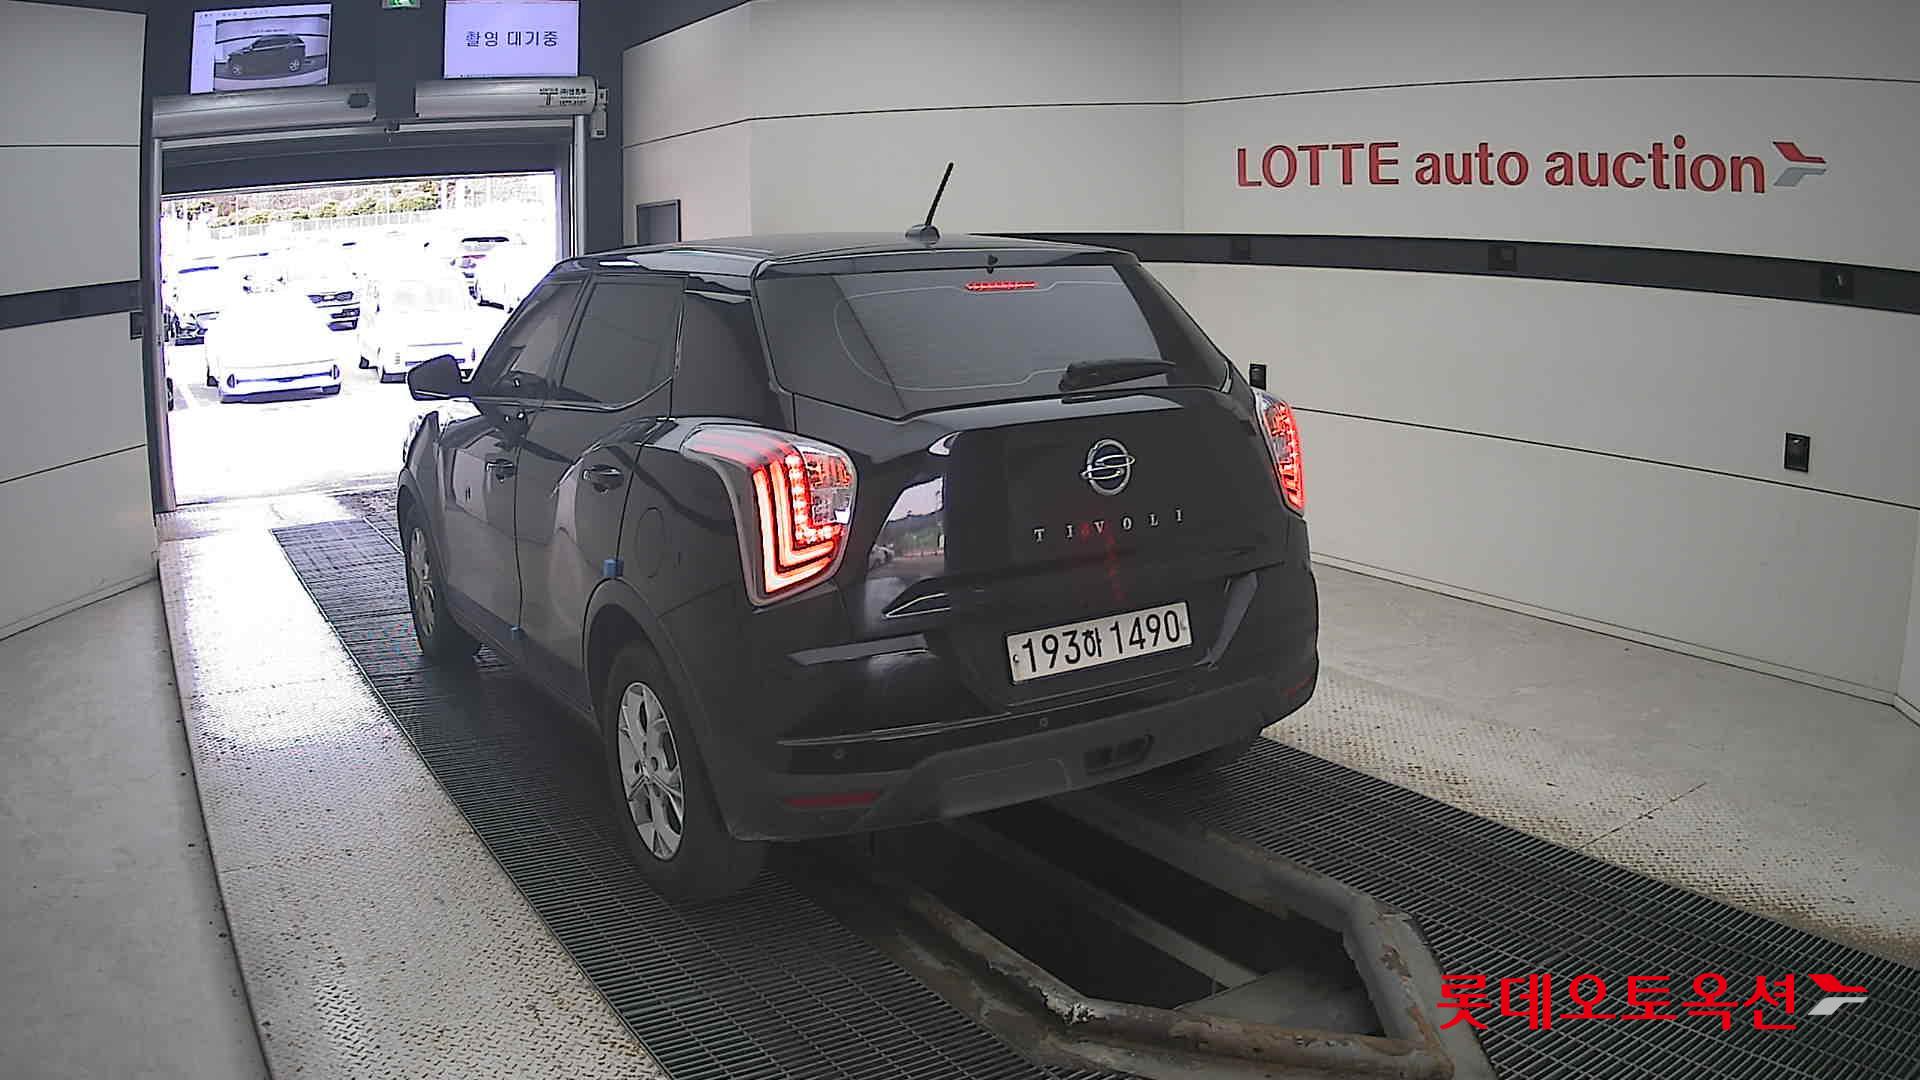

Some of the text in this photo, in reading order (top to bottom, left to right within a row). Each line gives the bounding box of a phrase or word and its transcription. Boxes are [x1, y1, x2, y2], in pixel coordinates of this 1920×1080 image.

[507, 31, 559, 47] 대기중
[1236, 134, 1766, 194] LOTTE auto auction
[1034, 508, 1184, 542] TIVOLI
[1021, 609, 1181, 674] 193하 1490
